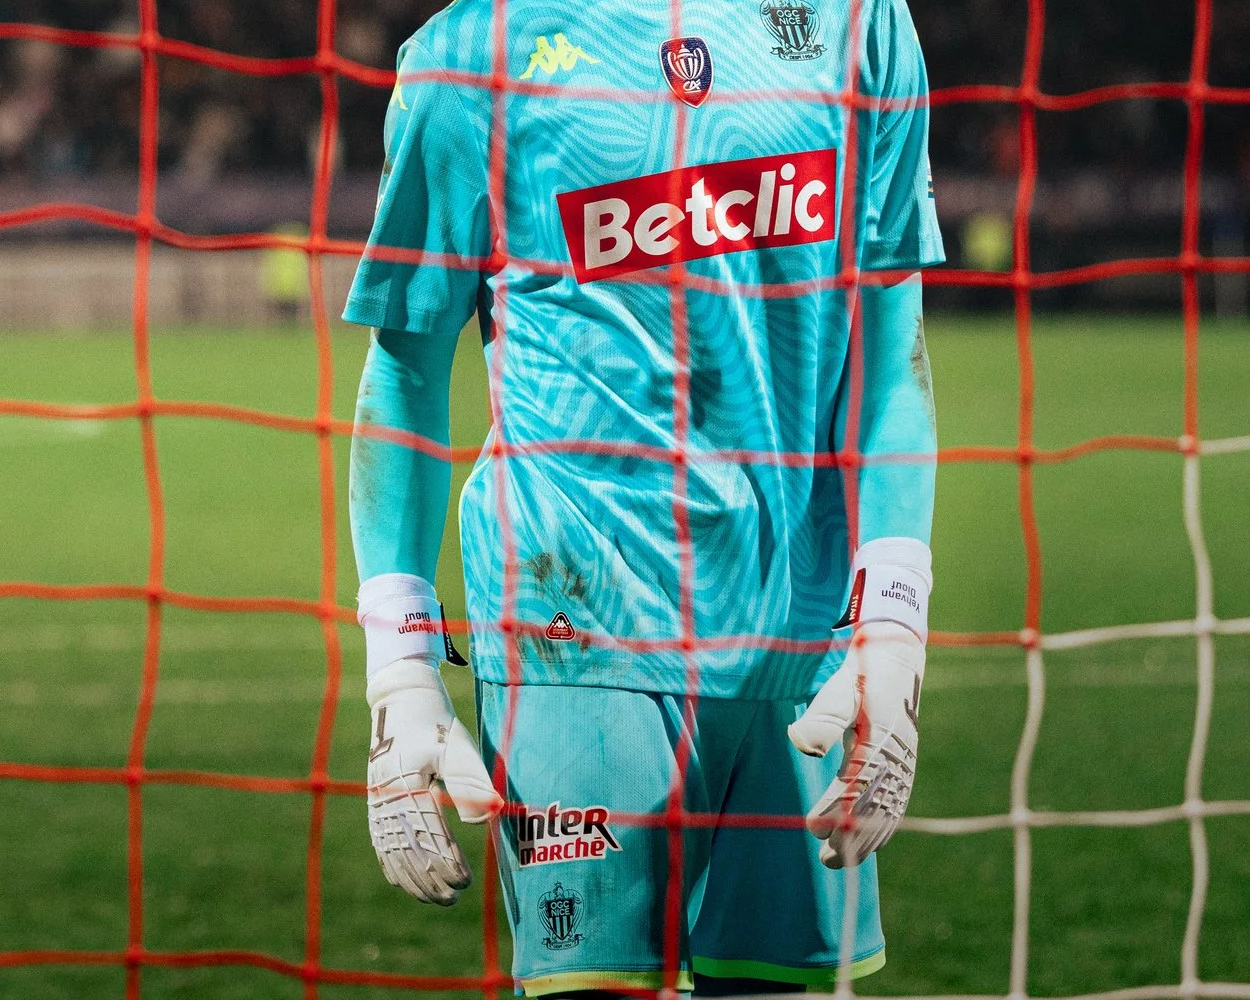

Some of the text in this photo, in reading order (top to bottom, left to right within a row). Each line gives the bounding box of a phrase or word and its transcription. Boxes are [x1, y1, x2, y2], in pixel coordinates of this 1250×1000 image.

[776, 9, 800, 18] OGC
[778, 17, 803, 25] NICE
[583, 162, 827, 271] Betclic
[890, 580, 917, 598] Diouf
[881, 589, 920, 613] Yehvann
[404, 611, 431, 624] Diouf
[398, 623, 438, 636] Yehvann
[550, 900, 570, 910] OGC
[550, 908, 571, 917] NICE
